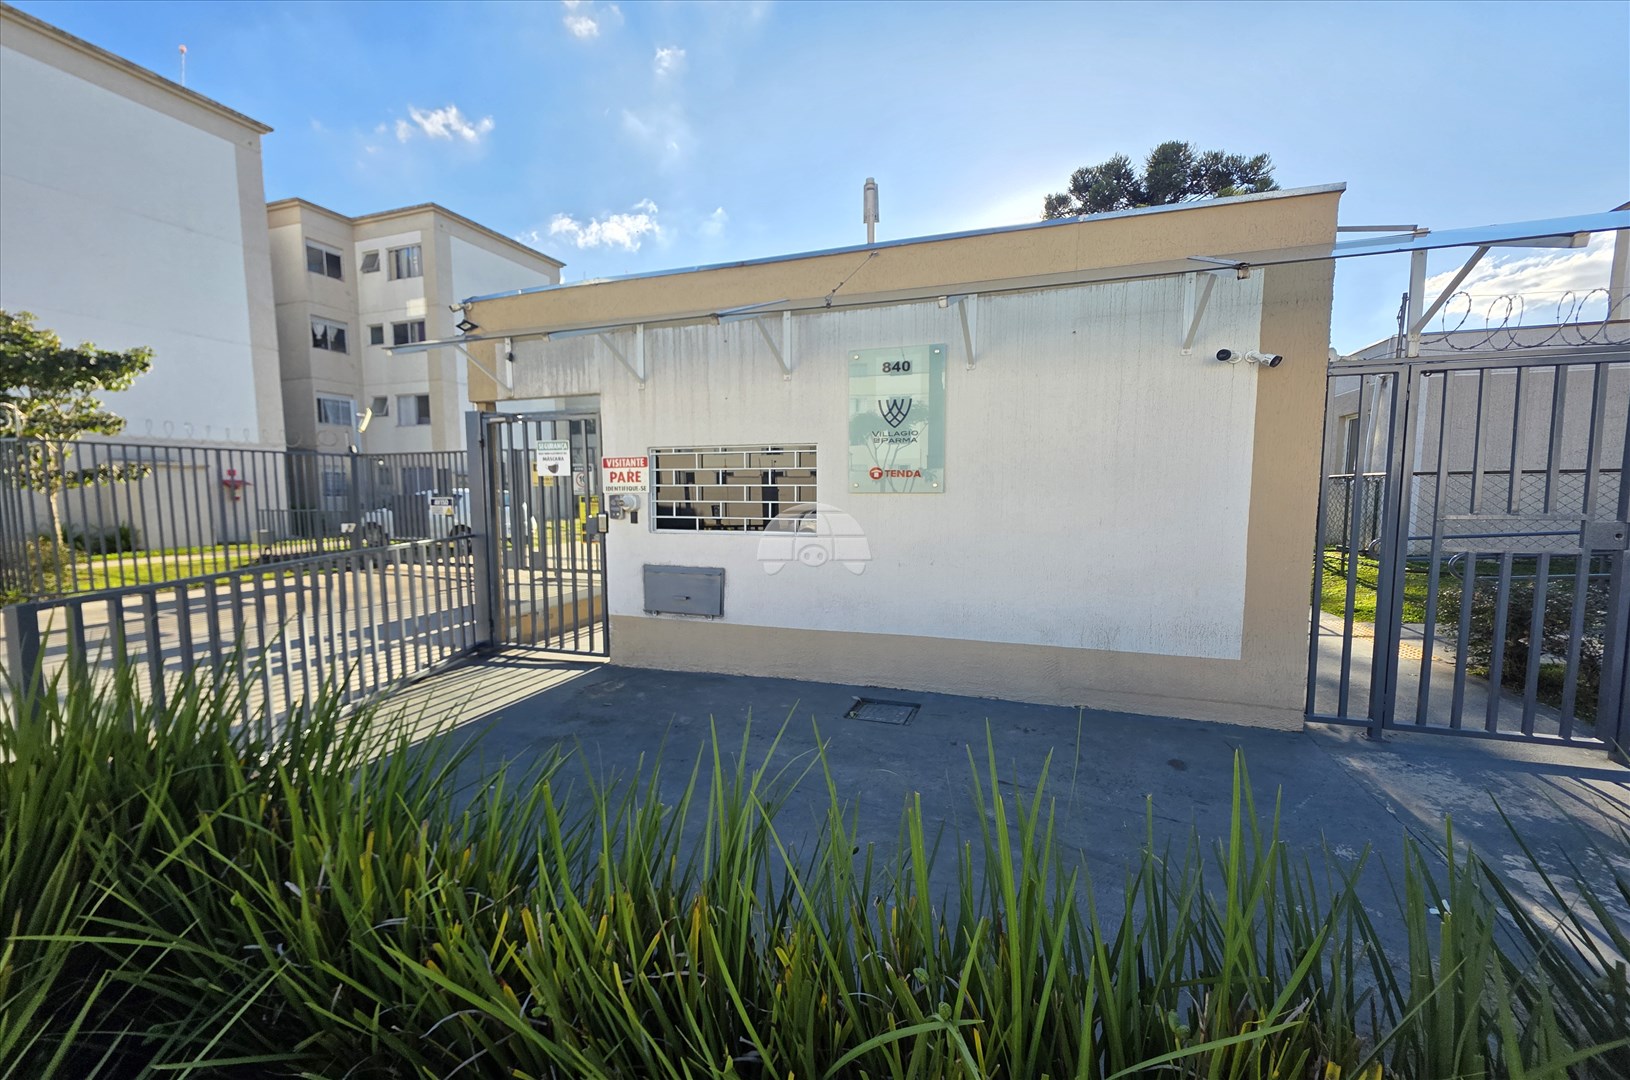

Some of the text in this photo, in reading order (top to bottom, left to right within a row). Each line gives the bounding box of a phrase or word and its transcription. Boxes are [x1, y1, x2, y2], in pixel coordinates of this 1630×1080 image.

[882, 361, 911, 373] 840
[606, 457, 645, 468] VISITANTE
[609, 471, 642, 483] PARE
[885, 470, 921, 478] TENDA
